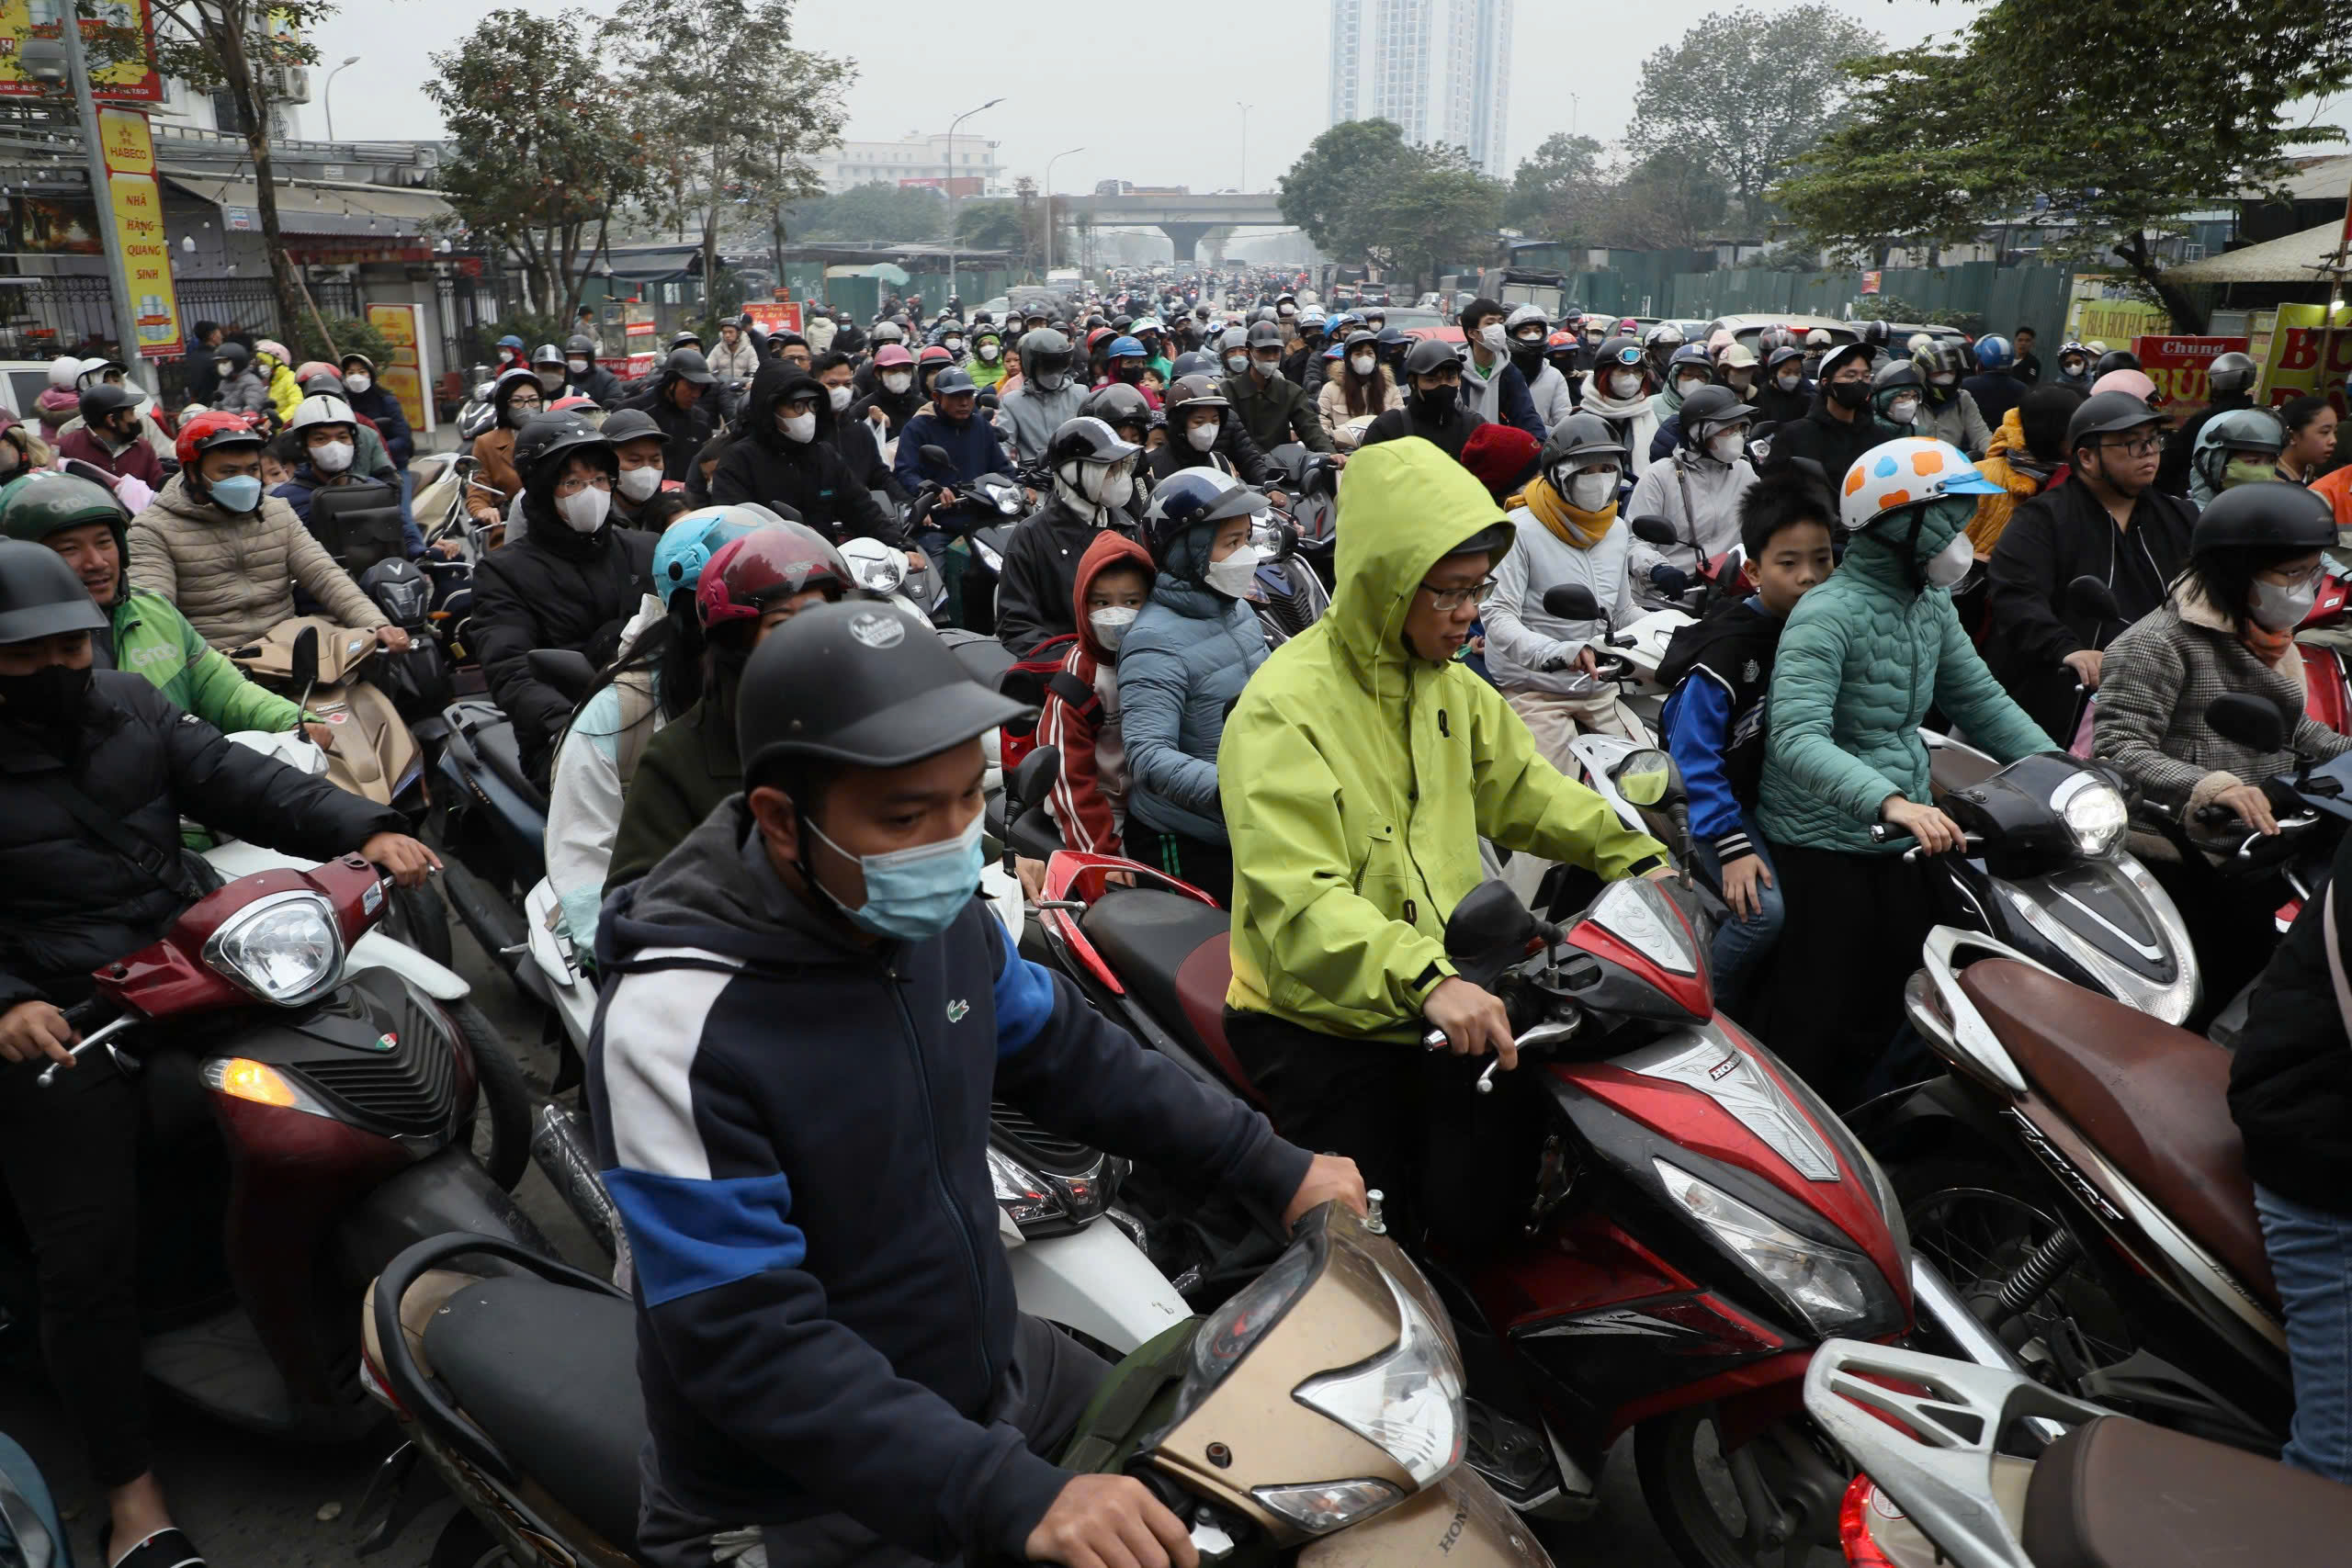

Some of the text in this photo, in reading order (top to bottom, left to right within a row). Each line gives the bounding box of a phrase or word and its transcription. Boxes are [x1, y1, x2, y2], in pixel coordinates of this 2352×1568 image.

[110, 147, 147, 160] HABECO
[127, 244, 161, 256] QUANG
[137, 269, 159, 280] SINH
[2162, 341, 2226, 356] Chung
[48, 492, 90, 515] Grab
[130, 642, 178, 669] Grab
